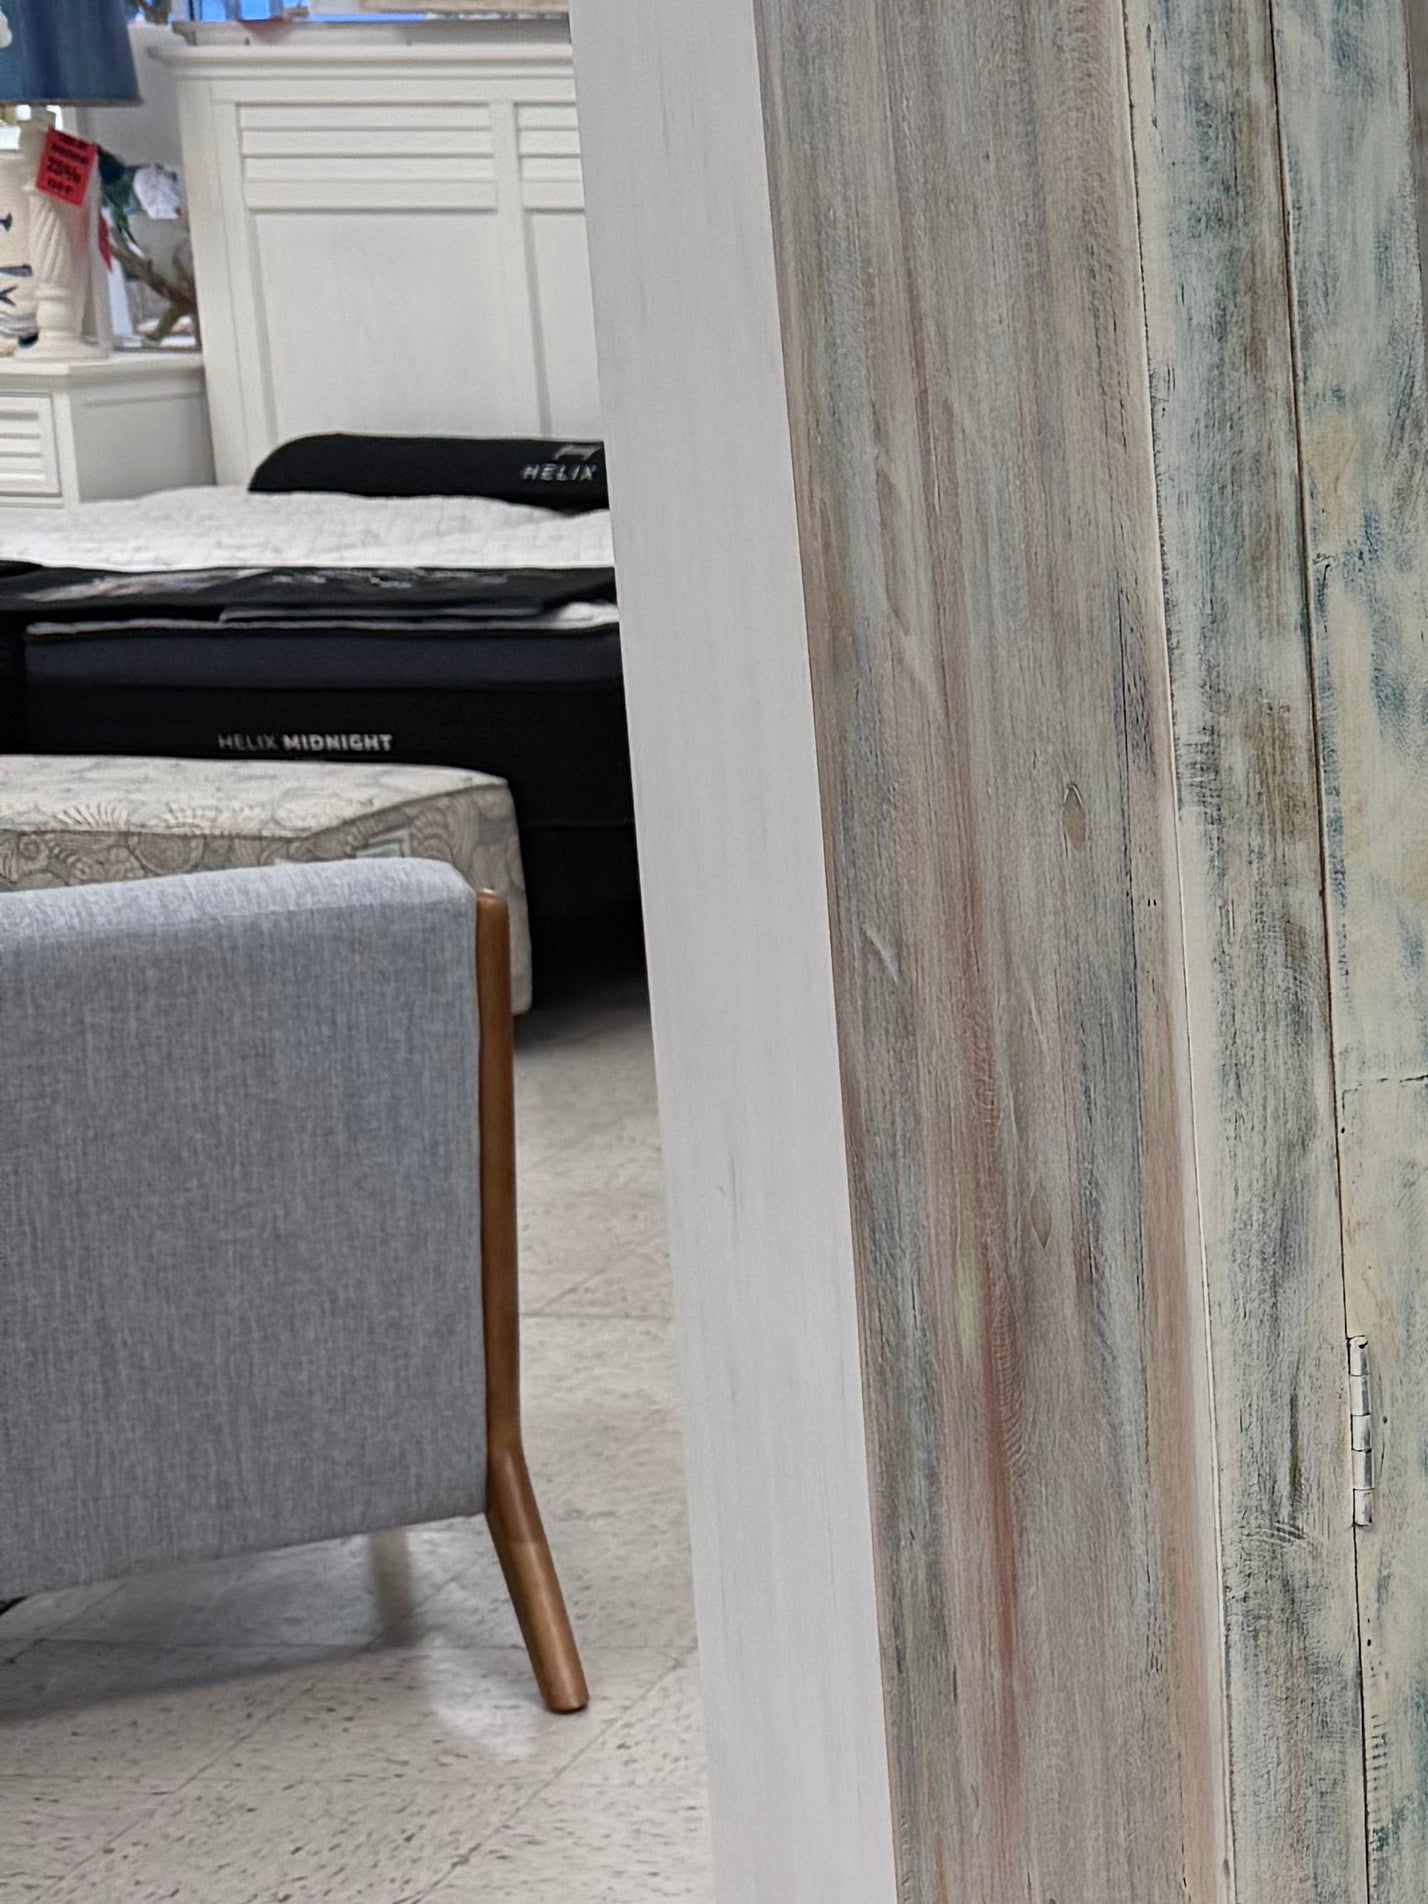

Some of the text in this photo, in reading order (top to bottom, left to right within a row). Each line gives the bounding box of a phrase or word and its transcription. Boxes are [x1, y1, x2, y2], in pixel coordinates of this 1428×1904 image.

[521, 463, 598, 482] HELIX
[217, 733, 392, 752] HELIX MIDNIGHT
